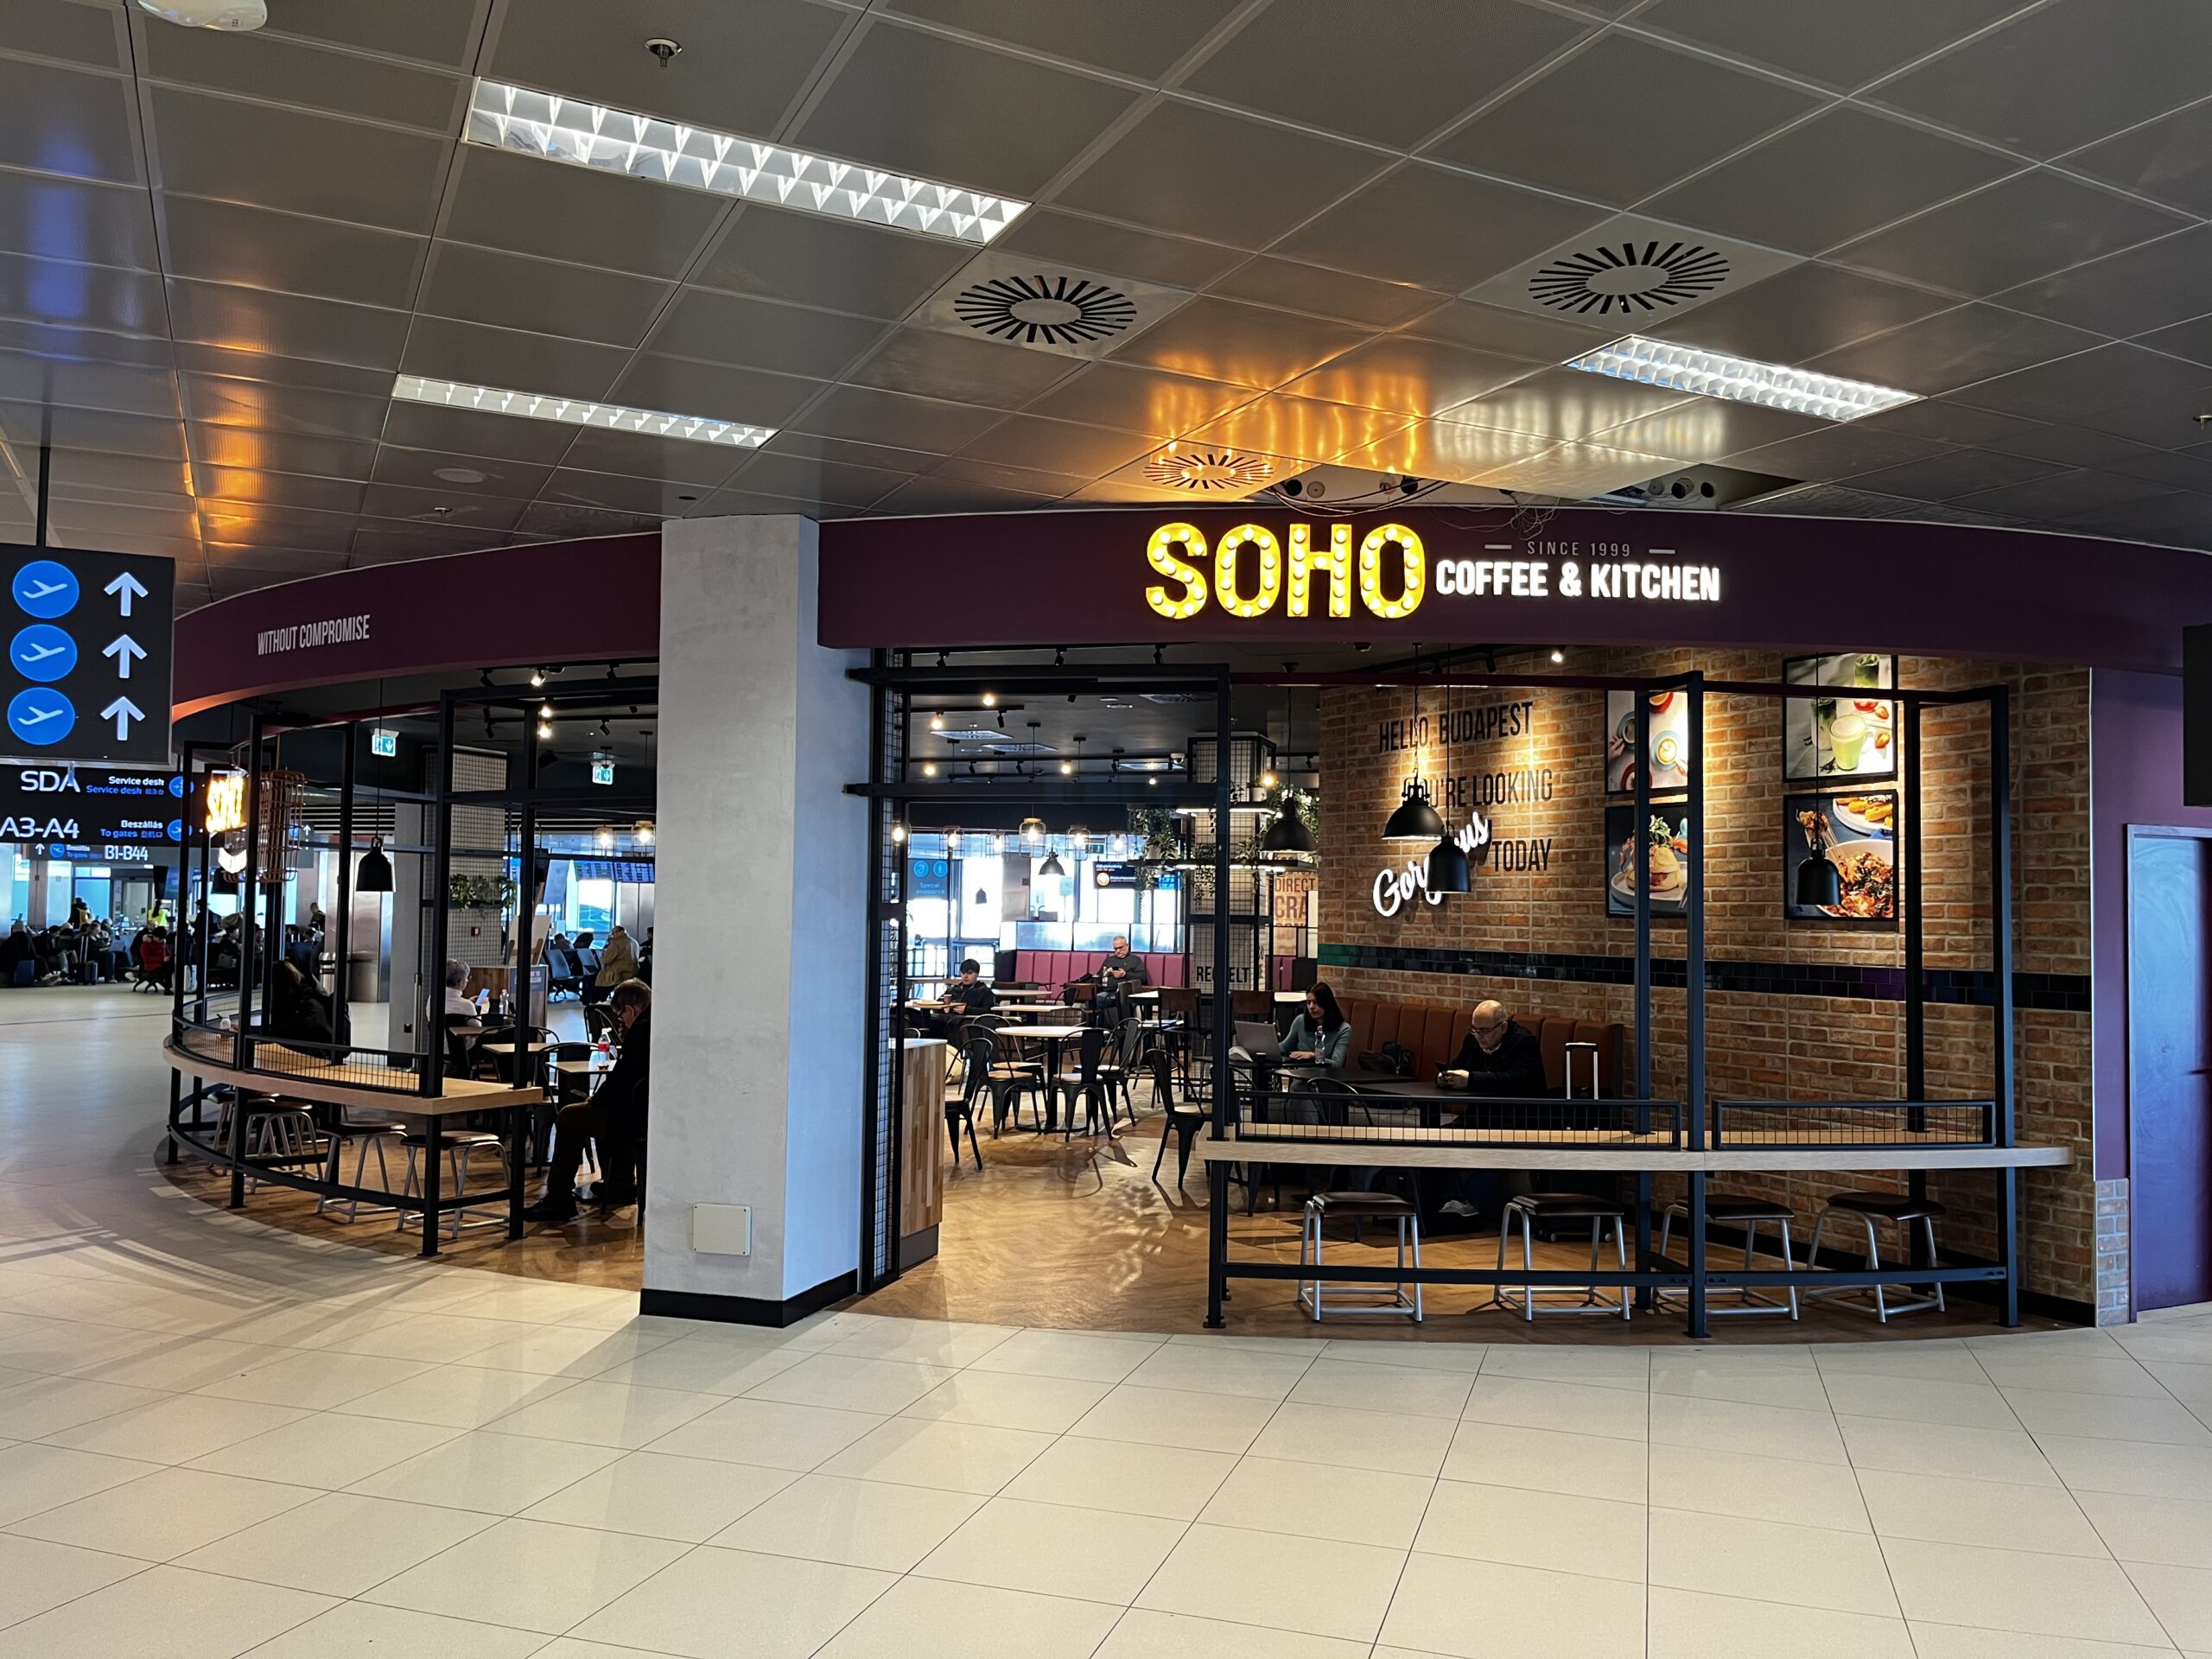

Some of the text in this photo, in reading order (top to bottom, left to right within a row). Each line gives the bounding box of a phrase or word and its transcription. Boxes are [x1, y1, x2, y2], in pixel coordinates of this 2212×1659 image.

[1527, 541, 1630, 557] SINCE 1999
[1146, 523, 1426, 620] SOHO
[1436, 560, 1719, 601] COFFEE & KITCHEN
[257, 614, 371, 656] WITHOUT COMPROMISE
[1439, 701, 1533, 745] BUDAPEST
[21, 771, 80, 792] SDA
[86, 785, 142, 795] Service desk
[109, 776, 164, 786] Service desk
[1420, 768, 1553, 809] U'RE LOOKING
[0, 817, 79, 838] A3-A4
[121, 819, 163, 829] Beszállás
[105, 844, 149, 861] B1-B44
[1492, 838, 1552, 872] TODAY
[1274, 878, 1316, 893] DIRECT
